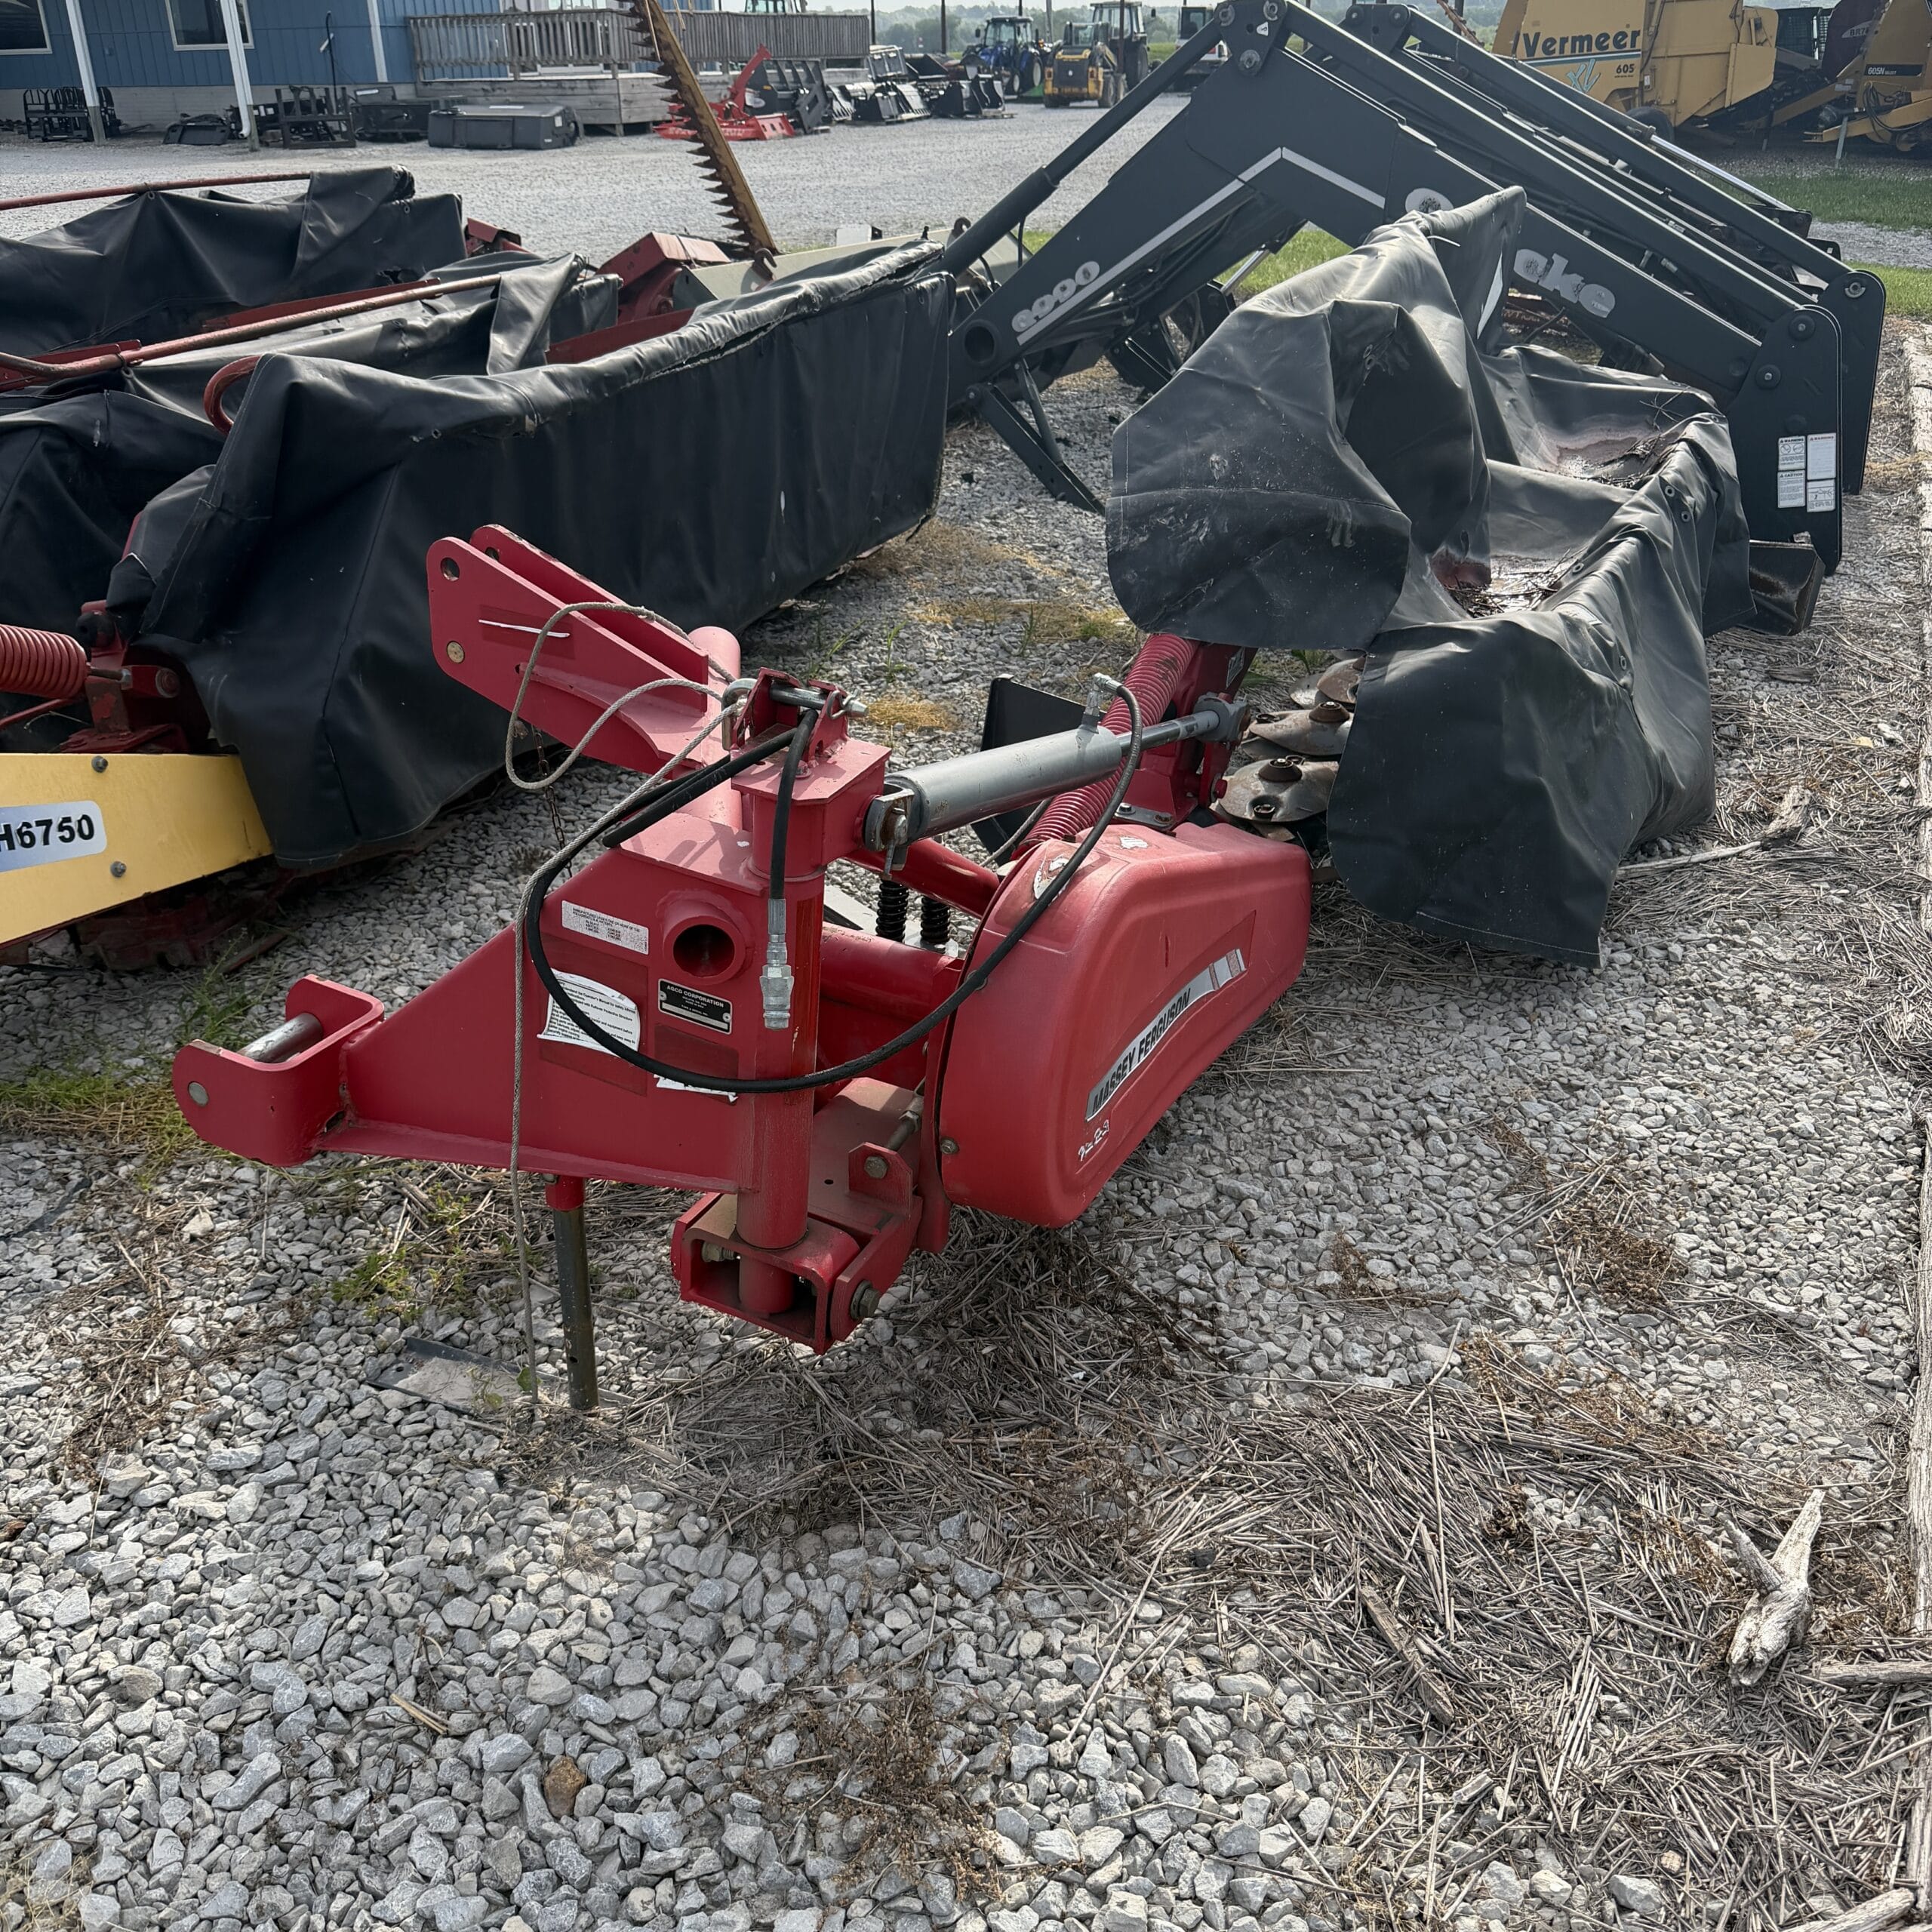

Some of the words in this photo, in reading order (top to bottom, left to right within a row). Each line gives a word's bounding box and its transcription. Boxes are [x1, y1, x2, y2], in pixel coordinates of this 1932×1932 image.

[1523, 29, 1641, 58] Vermeer
[1567, 58, 1601, 93] XL
[1616, 63, 1635, 74] 605
[683, 990, 724, 1008] CORPORATION
[1093, 1047, 1136, 1112] MASSEY
[1138, 988, 1191, 1062] FERGUSON
